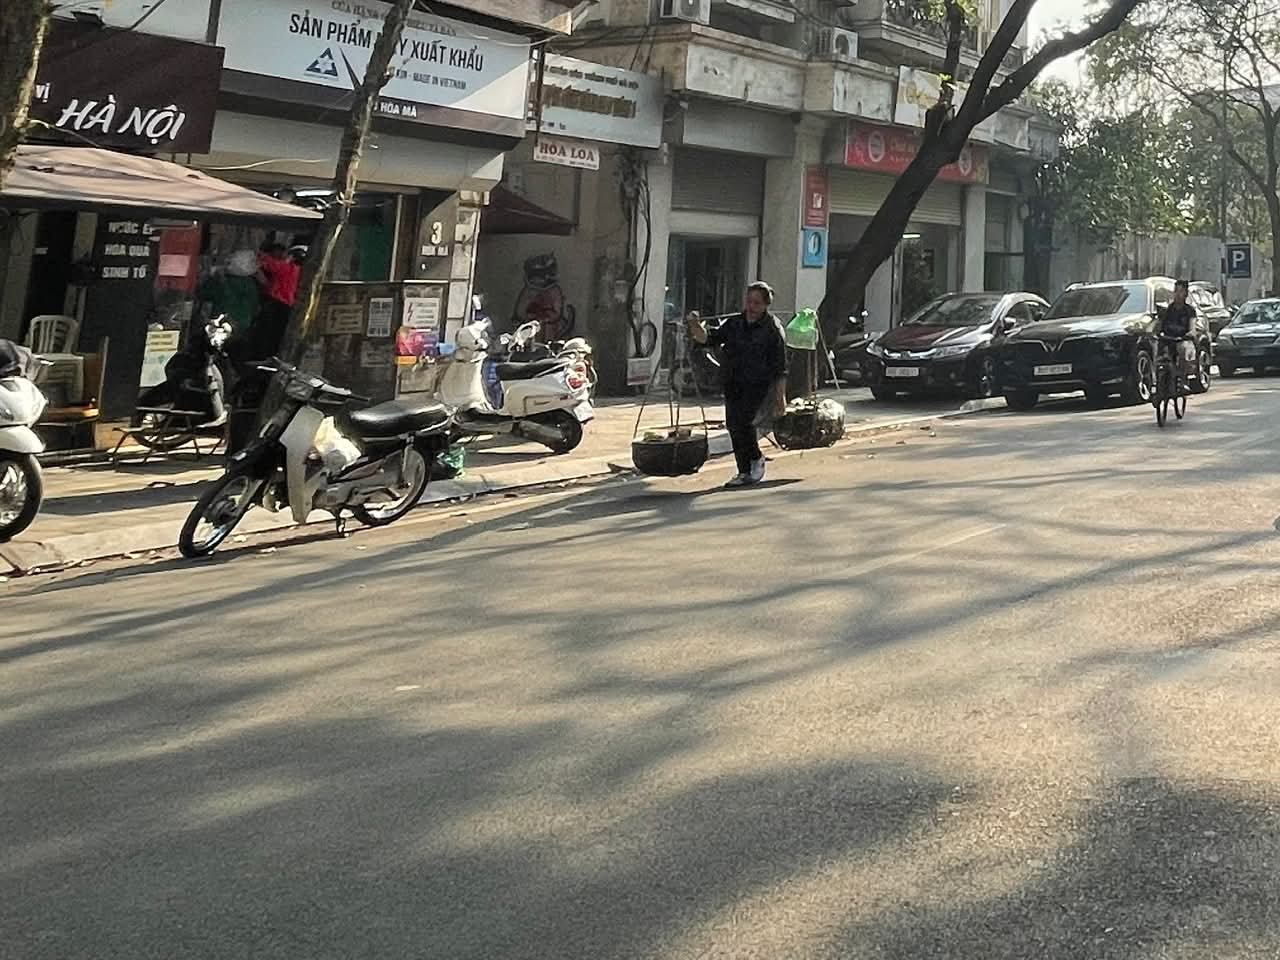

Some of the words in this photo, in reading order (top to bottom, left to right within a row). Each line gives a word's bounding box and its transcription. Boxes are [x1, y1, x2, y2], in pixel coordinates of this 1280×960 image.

[289, 8, 323, 39] SẢN
[326, 18, 372, 49] PHẨM
[410, 38, 446, 65] XUẤT
[449, 44, 484, 72] KHẨU
[55, 94, 117, 134] HÀ
[117, 104, 186, 145] NỘI
[430, 221, 443, 245] 3
[1232, 250, 1245, 268] P
